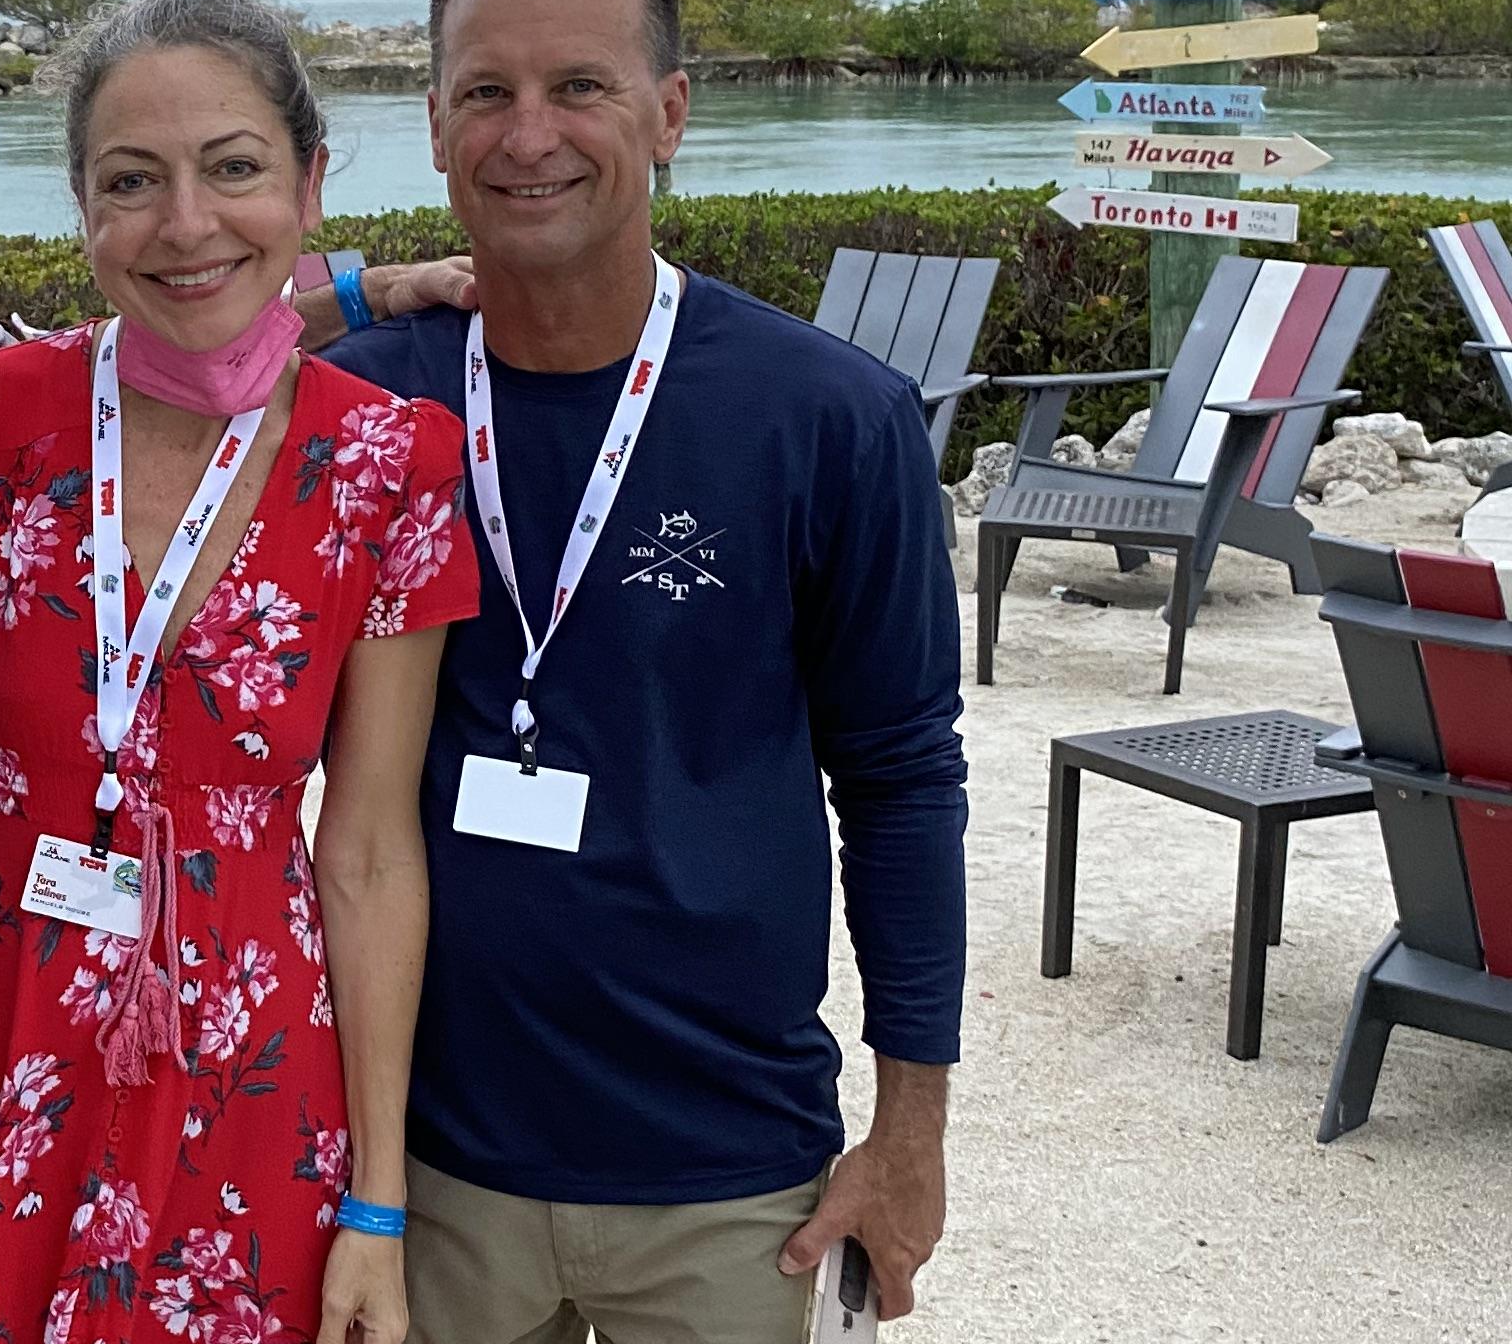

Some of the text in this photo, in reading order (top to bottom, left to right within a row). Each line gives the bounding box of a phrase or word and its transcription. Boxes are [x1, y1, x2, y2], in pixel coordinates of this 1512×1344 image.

[1117, 92, 1217, 117] Atlanta
[1223, 107, 1254, 119] Miles
[1090, 139, 1112, 150] 147
[1083, 152, 1115, 164] Miles
[1126, 139, 1235, 170] Havana
[1091, 194, 1193, 228] Toronto
[628, 546, 716, 560] MM VI
[35, 872, 57, 887] Tara
